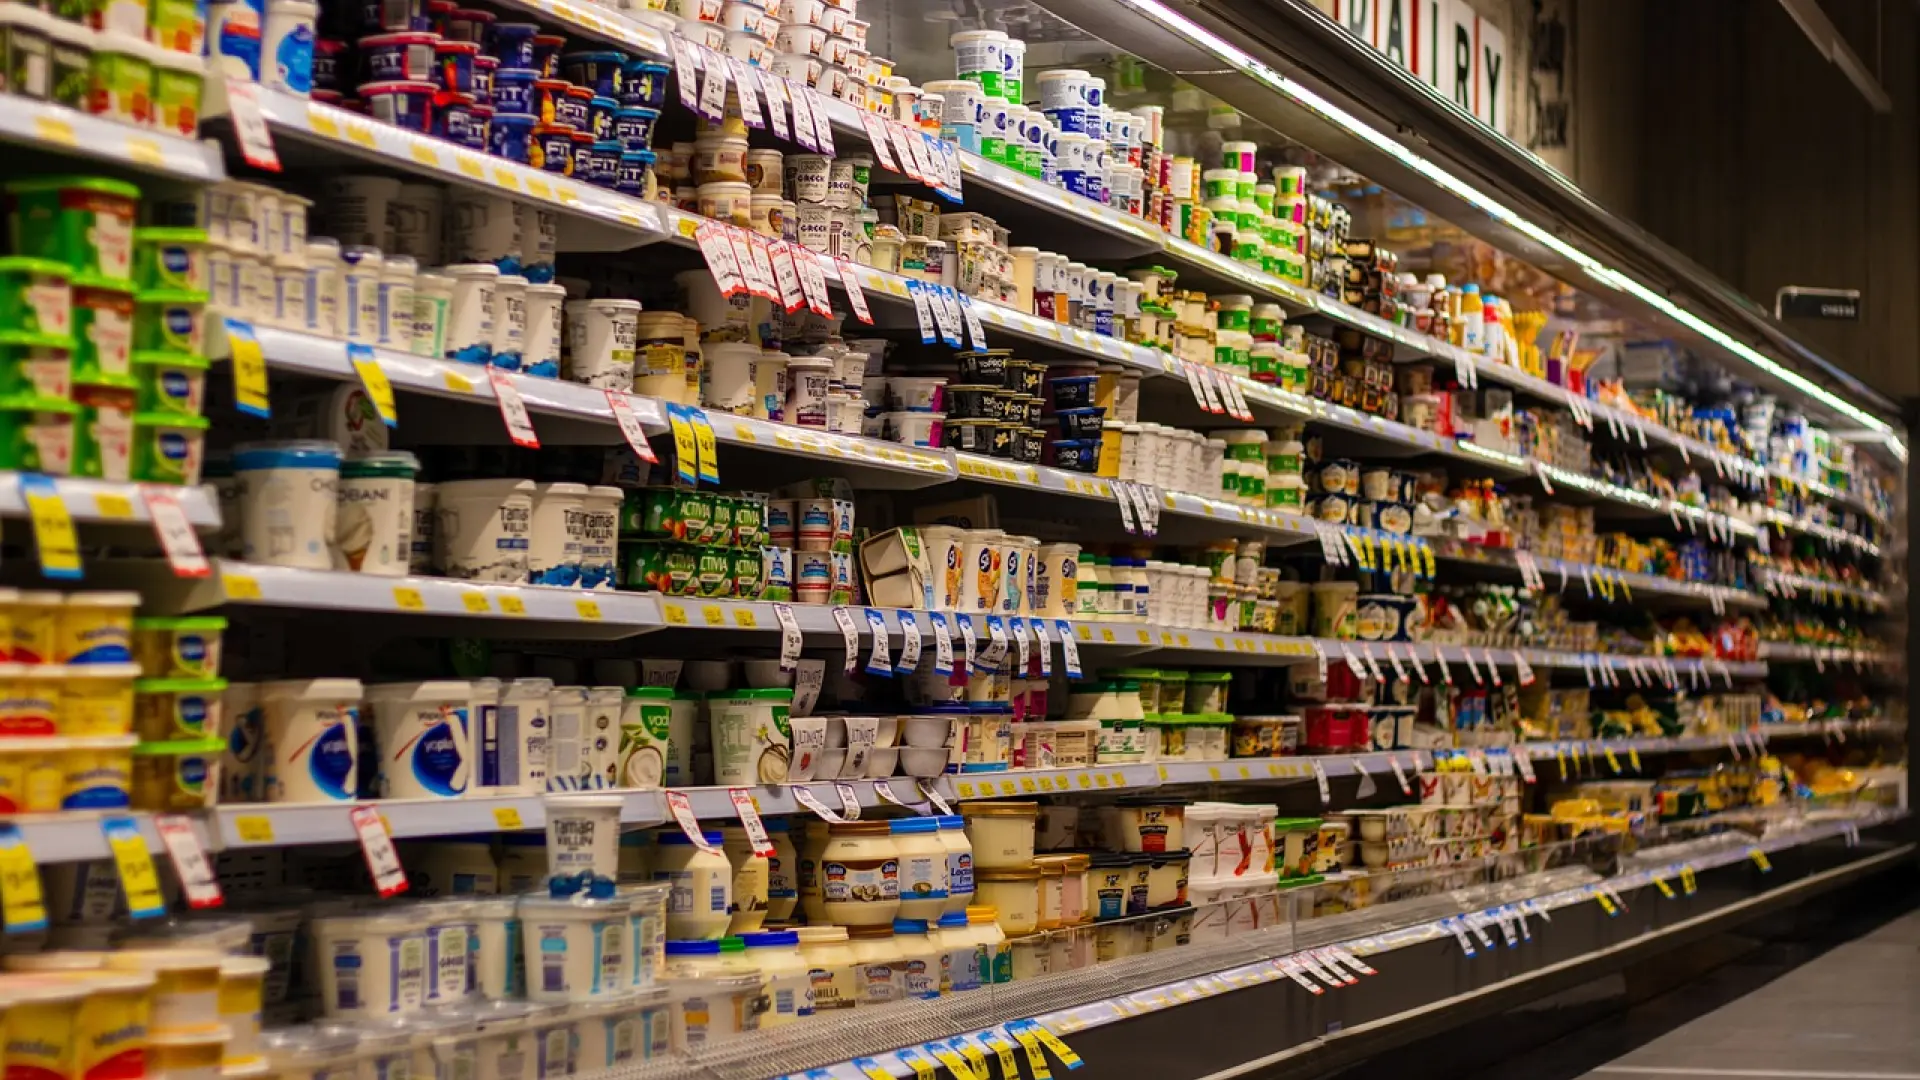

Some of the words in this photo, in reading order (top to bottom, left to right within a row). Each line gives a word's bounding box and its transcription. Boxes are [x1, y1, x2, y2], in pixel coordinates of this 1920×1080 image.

[616, 123, 648, 137] FiT
[680, 501, 711, 519] ACTIVIA
[735, 508, 760, 525] ACTIVIA
[735, 559, 760, 575] ACTIVIA
